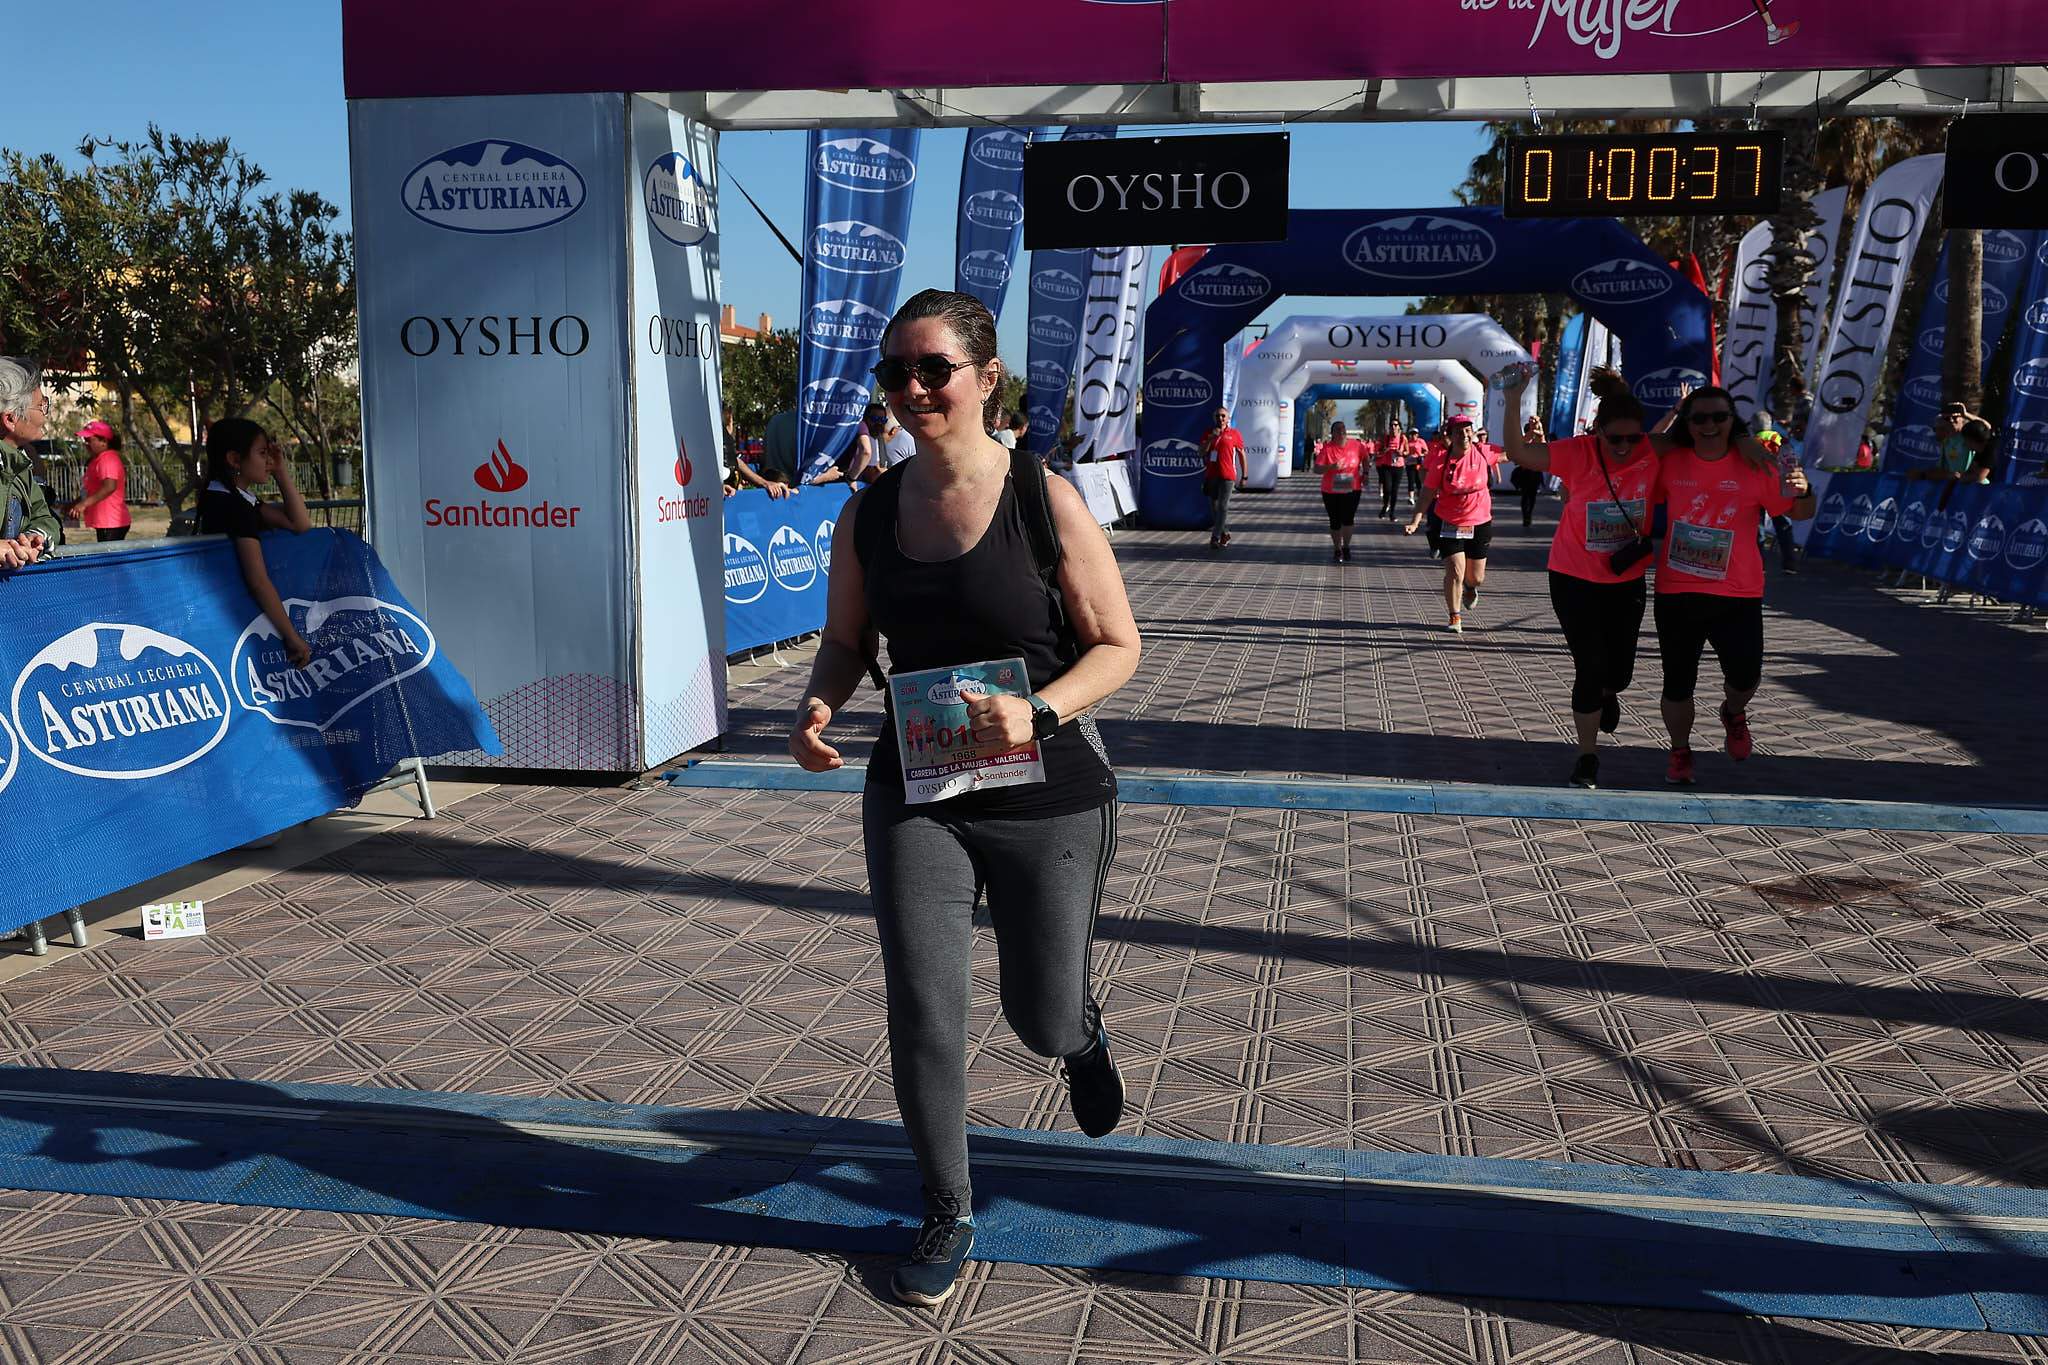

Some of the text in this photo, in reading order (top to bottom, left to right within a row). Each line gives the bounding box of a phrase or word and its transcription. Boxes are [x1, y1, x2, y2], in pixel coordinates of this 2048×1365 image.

[443, 172, 566, 183] CENTRAL LECHERA
[416, 175, 573, 211] ASTURIANA
[1066, 171, 1250, 213] OYSHO
[1353, 235, 1485, 263] ASTURIANA
[1185, 281, 1264, 297] ASTURIANA
[1820, 198, 1917, 415] OYSHO
[401, 316, 589, 357] OYSHO
[649, 314, 713, 361] OYSHO
[1328, 324, 1447, 349] OYSHO
[1257, 352, 1293, 361] OYSHO
[1639, 384, 1681, 398] ASTUR
[425, 499, 581, 528] Santander
[657, 495, 710, 523] Santander
[724, 563, 766, 588] STURIANA
[61, 661, 202, 698] CENTRAL LECHERA
[247, 628, 423, 706] ASTURIANA
[37, 682, 223, 754] ASTURIANA
[910, 769, 938, 779] CARRERA
[938, 766, 949, 774] DE
[961, 759, 989, 770] MUJER
[994, 752, 1032, 764] VALENCIA
[984, 769, 1028, 781] Santander
[917, 778, 957, 795] OYSHO
